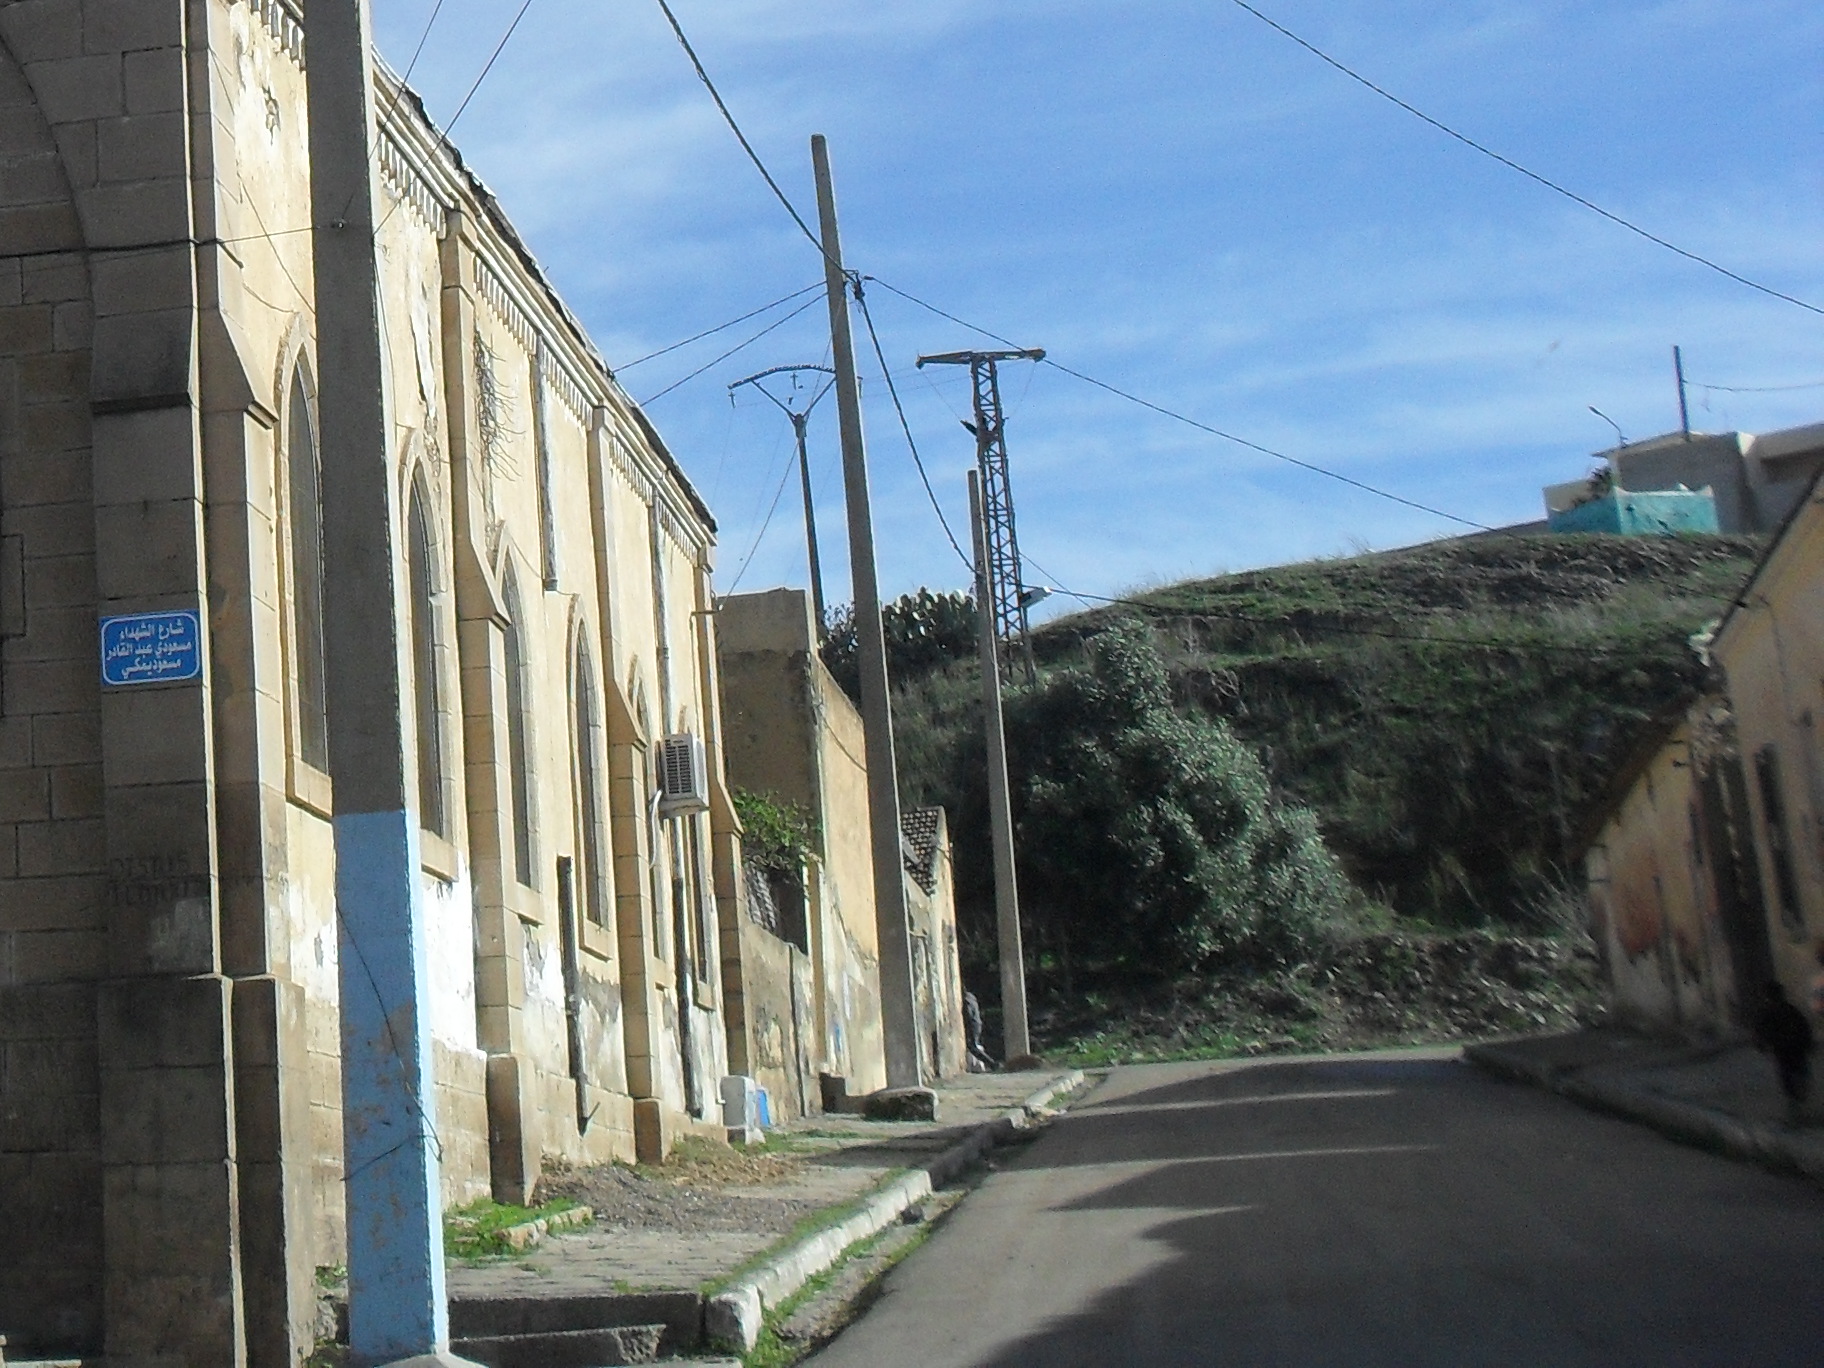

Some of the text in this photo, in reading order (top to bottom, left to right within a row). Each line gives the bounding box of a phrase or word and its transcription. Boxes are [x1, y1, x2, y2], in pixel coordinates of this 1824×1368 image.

[120, 618, 184, 641] شارع الشهداء
[106, 642, 134, 661] القادر
[135, 643, 154, 659] عبد
